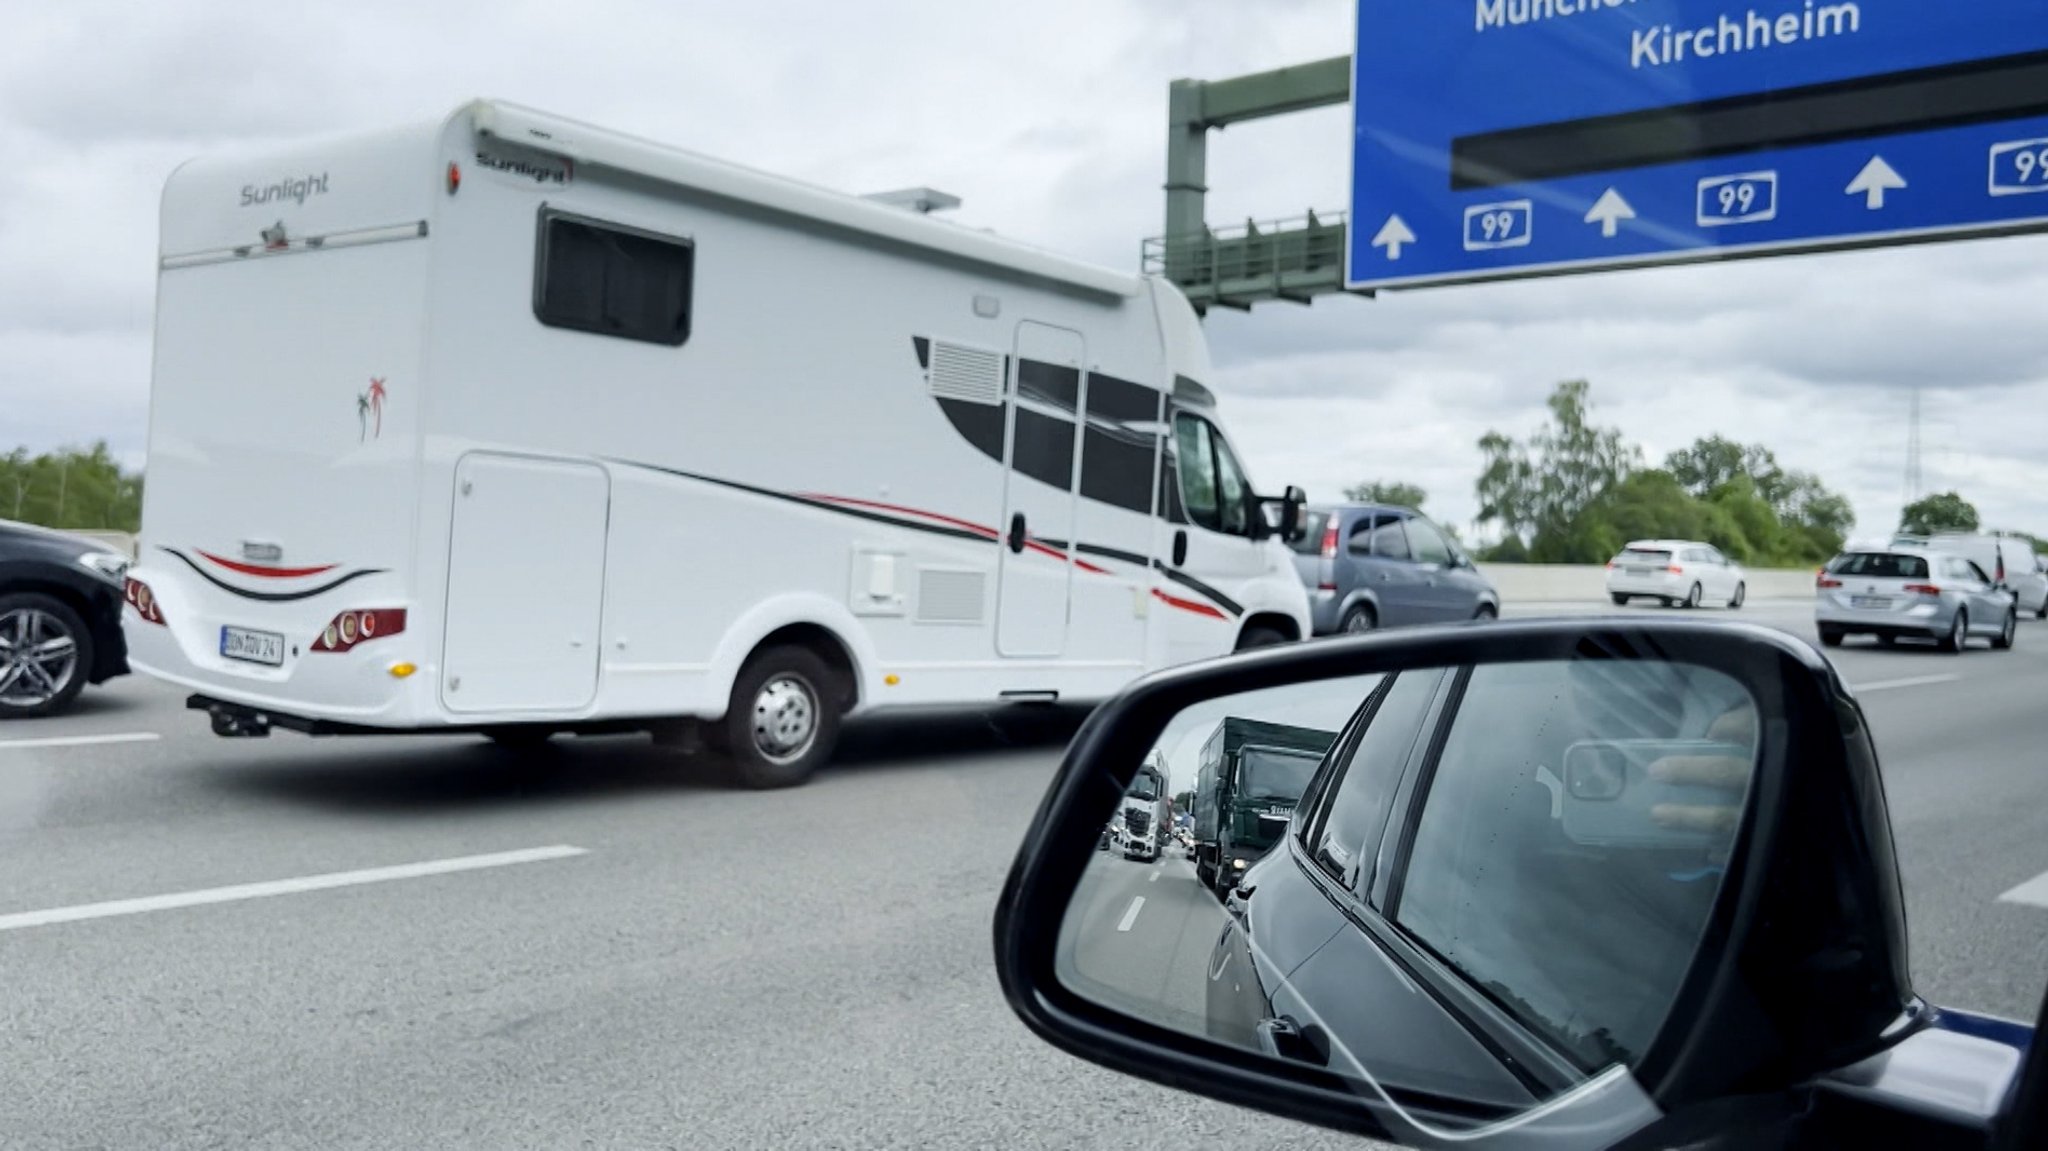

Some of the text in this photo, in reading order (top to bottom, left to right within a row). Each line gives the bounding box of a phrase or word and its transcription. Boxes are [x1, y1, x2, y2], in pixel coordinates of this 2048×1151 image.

[1631, 0, 1860, 69] Kirchheim
[240, 171, 329, 207] Sunlight
[1718, 182, 1755, 215] 99
[1481, 211, 1514, 240] 99
